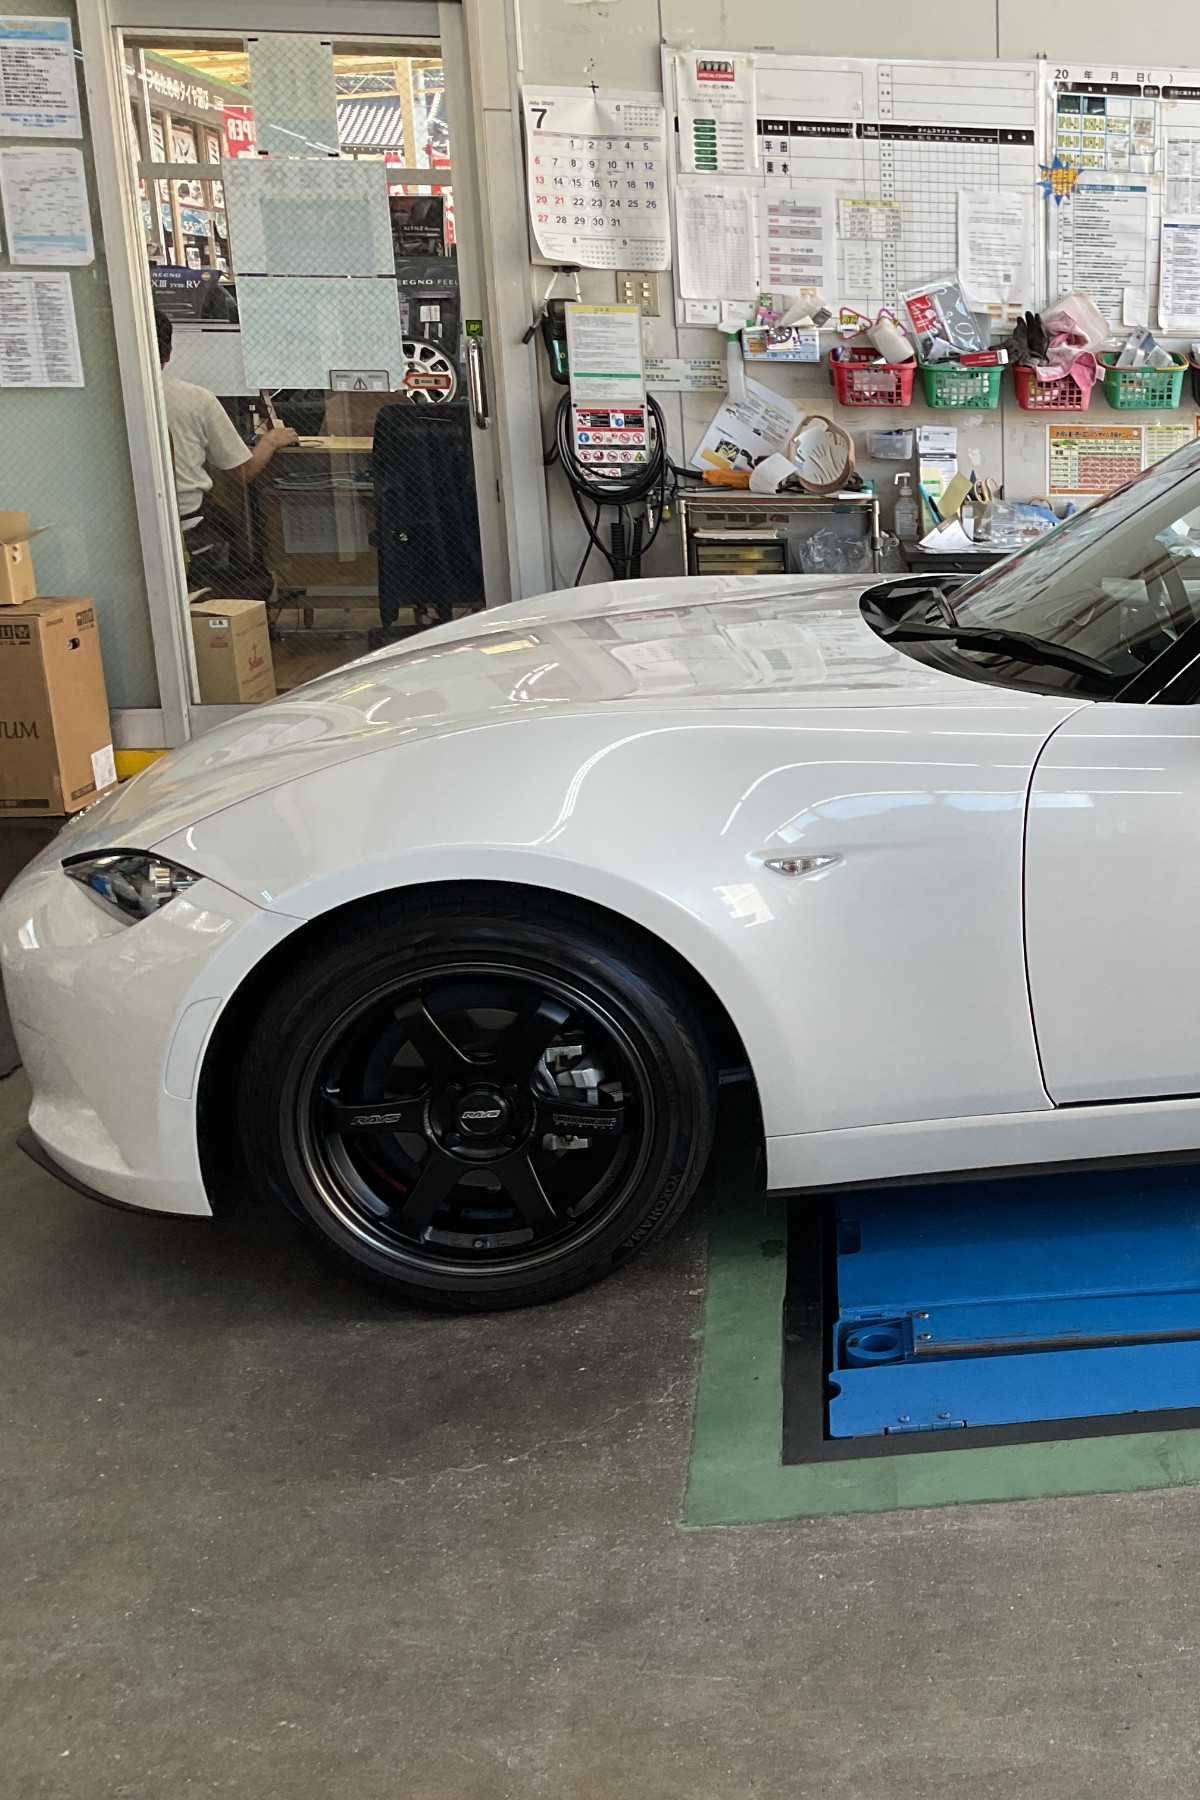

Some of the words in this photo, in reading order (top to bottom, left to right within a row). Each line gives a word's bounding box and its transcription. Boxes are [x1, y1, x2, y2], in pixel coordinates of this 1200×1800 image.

[1055, 70, 1068, 80] 20
[1084, 71, 1093, 80] 年
[1110, 72, 1119, 81] 月
[531, 108, 547, 129] 7
[570, 140, 574, 148] 1
[588, 142, 594, 150] 2
[606, 142, 612, 150] 3
[624, 142, 630, 150] 4
[643, 142, 648, 150] 5
[535, 156, 540, 164] 6
[553, 158, 558, 166] 7
[571, 160, 576, 168] 8
[590, 161, 595, 169] 9
[608, 161, 617, 169] 10
[644, 162, 653, 170] 12
[535, 176, 544, 184] 13
[554, 178, 563, 186] 14
[572, 179, 582, 187] 15
[591, 180, 600, 188] 16
[645, 181, 654, 189] 19
[536, 196, 547, 204] 20
[573, 198, 584, 206] 22
[628, 200, 638, 208] 25
[556, 216, 567, 224] 28
[574, 217, 585, 225] 29
[593, 218, 603, 226] 30
[186, 280, 201, 289] RV
[0, 721, 40, 739] UM
[350, 1113, 402, 1125] RAYS
[461, 1109, 501, 1119] RAYS
[622, 1174, 682, 1248] YOKOHAMA
